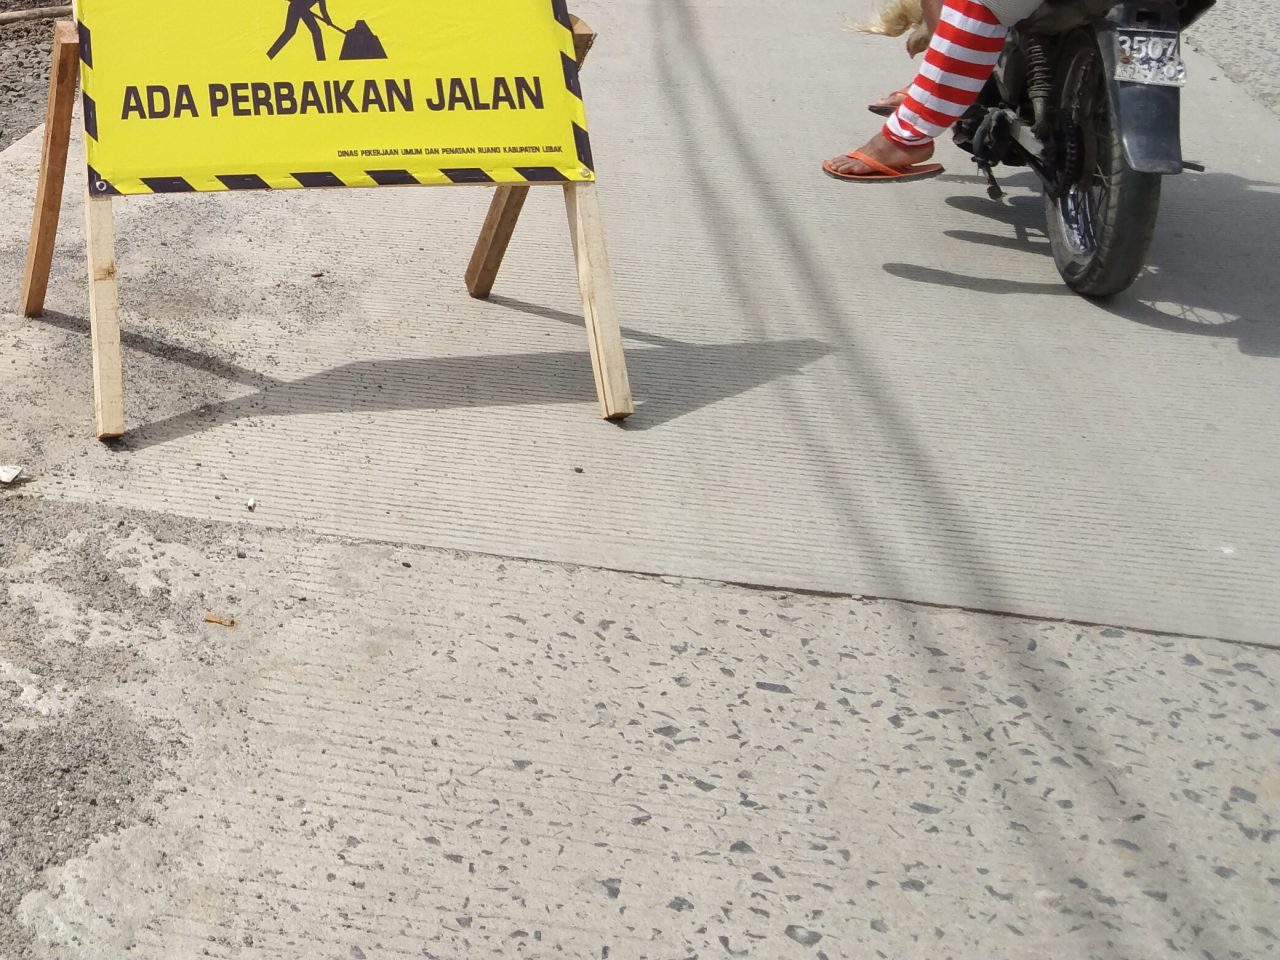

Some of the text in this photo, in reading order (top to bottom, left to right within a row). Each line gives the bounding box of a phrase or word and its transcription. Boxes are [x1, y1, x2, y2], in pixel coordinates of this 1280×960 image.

[121, 77, 544, 119] ADA PERBAIKAN JALAN
[337, 145, 563, 158] DINAS PEKERJAAN UMUM DAN PENATAAN RUANG KABUPATEN LEBAK
